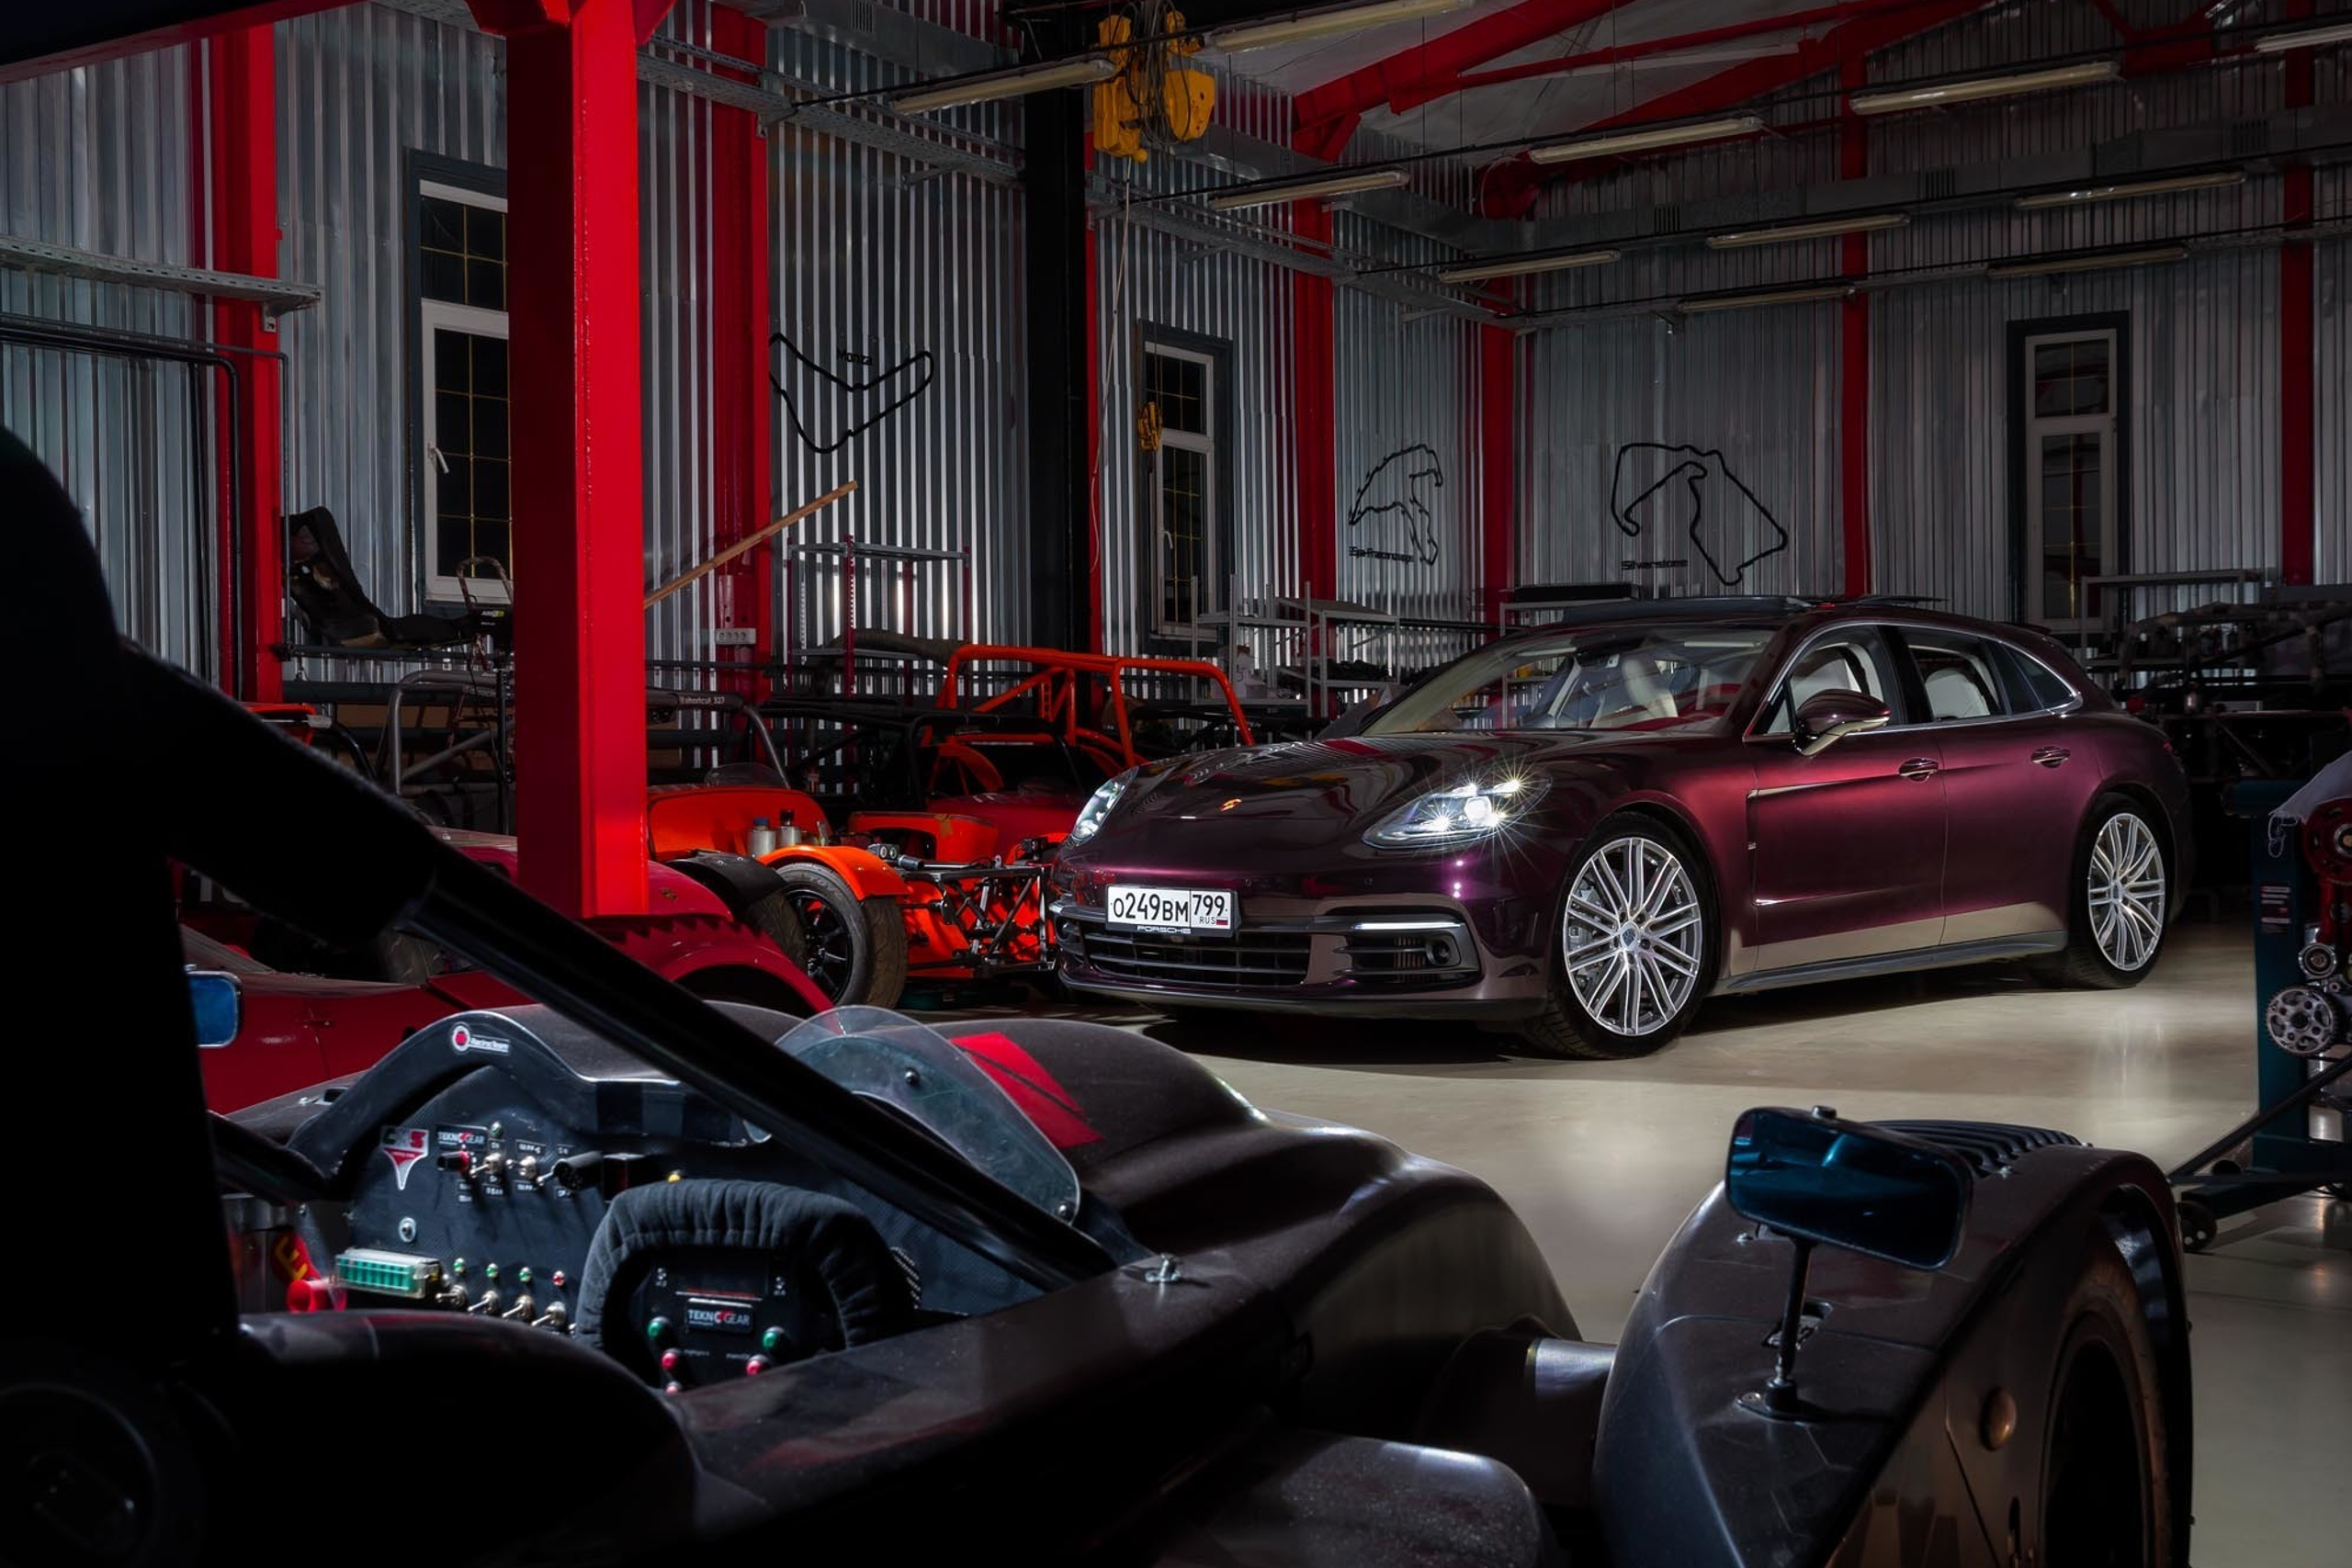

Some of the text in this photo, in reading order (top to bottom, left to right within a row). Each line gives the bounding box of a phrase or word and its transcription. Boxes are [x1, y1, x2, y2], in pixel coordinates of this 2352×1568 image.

[837, 348, 873, 366] Monza
[1193, 894, 1226, 917] 799
[1199, 916, 1216, 925] RUS
[1136, 925, 1192, 934] PORSCHE
